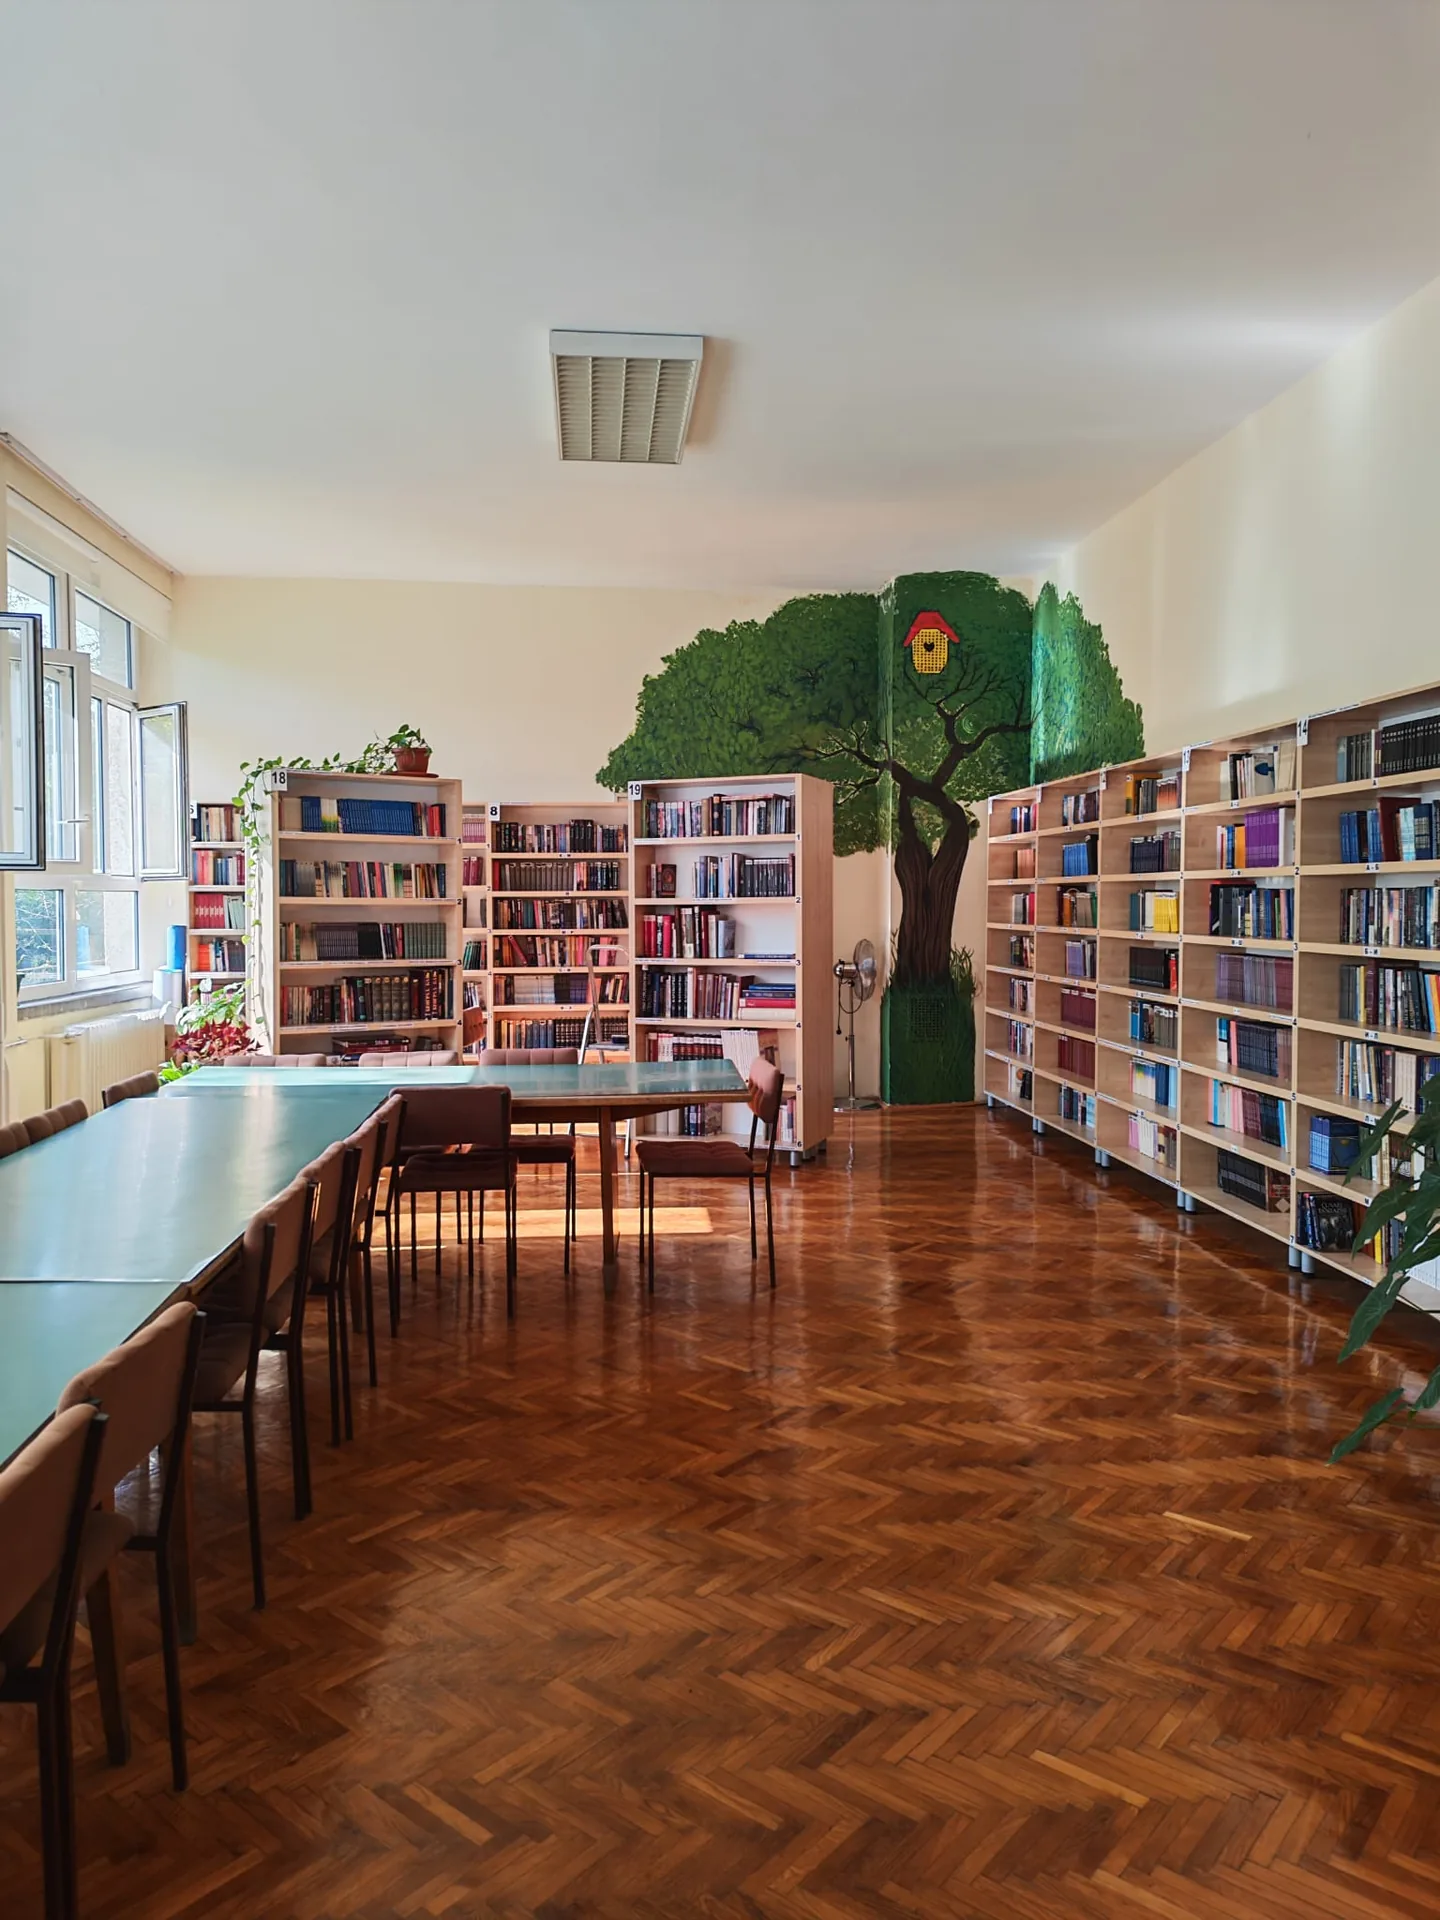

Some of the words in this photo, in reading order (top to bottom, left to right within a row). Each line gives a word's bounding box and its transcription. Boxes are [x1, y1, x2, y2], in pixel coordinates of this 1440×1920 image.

[1298, 720, 1308, 736] 14
[272, 771, 286, 784] 18
[629, 784, 641, 795] 19
[1297, 791, 1300, 799] 1
[490, 806, 497, 816] 8
[1295, 867, 1300, 875] 2
[1294, 943, 1298, 951] 3
[1292, 1018, 1297, 1026] 4
[1291, 1092, 1296, 1101] 5
[1291, 1168, 1295, 1176] 6
[1290, 1234, 1294, 1244] 7
